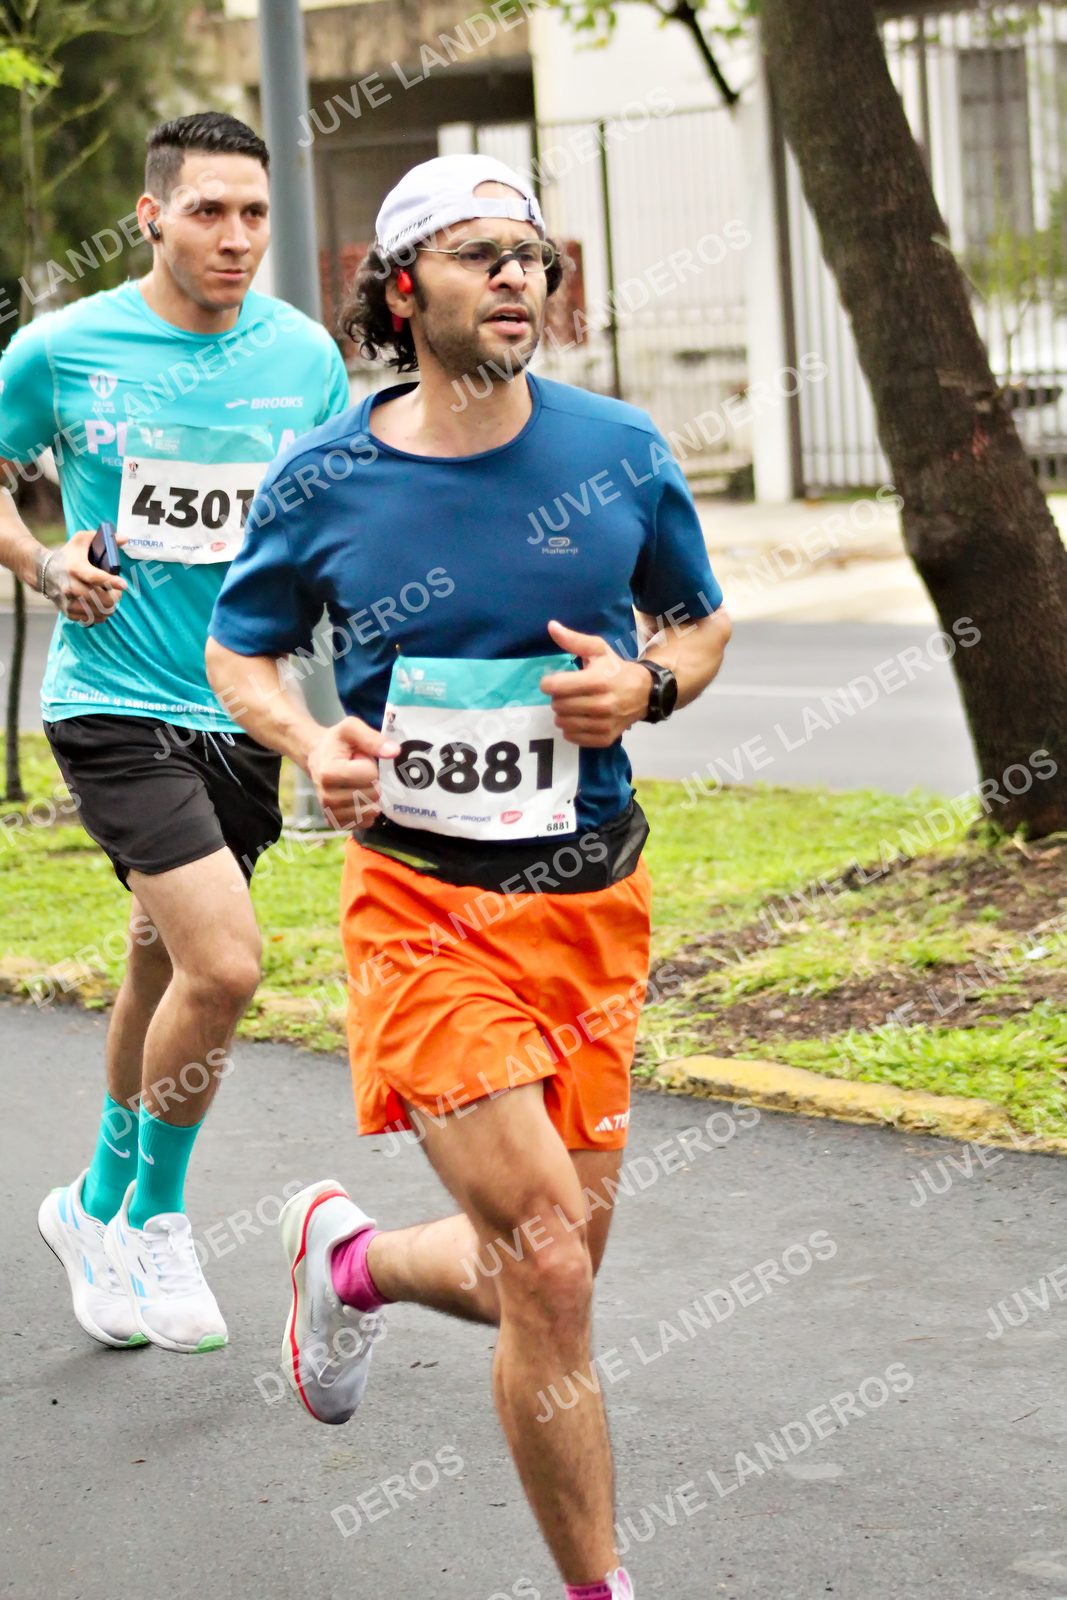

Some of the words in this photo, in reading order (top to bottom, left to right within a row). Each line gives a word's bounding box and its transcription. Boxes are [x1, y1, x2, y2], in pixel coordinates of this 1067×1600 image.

[251, 397, 303, 409] BROOKS
[127, 538, 164, 549] PERDURA
[393, 738, 554, 794] 6881
[393, 803, 437, 818] PERDURA
[546, 821, 569, 832] 6881
